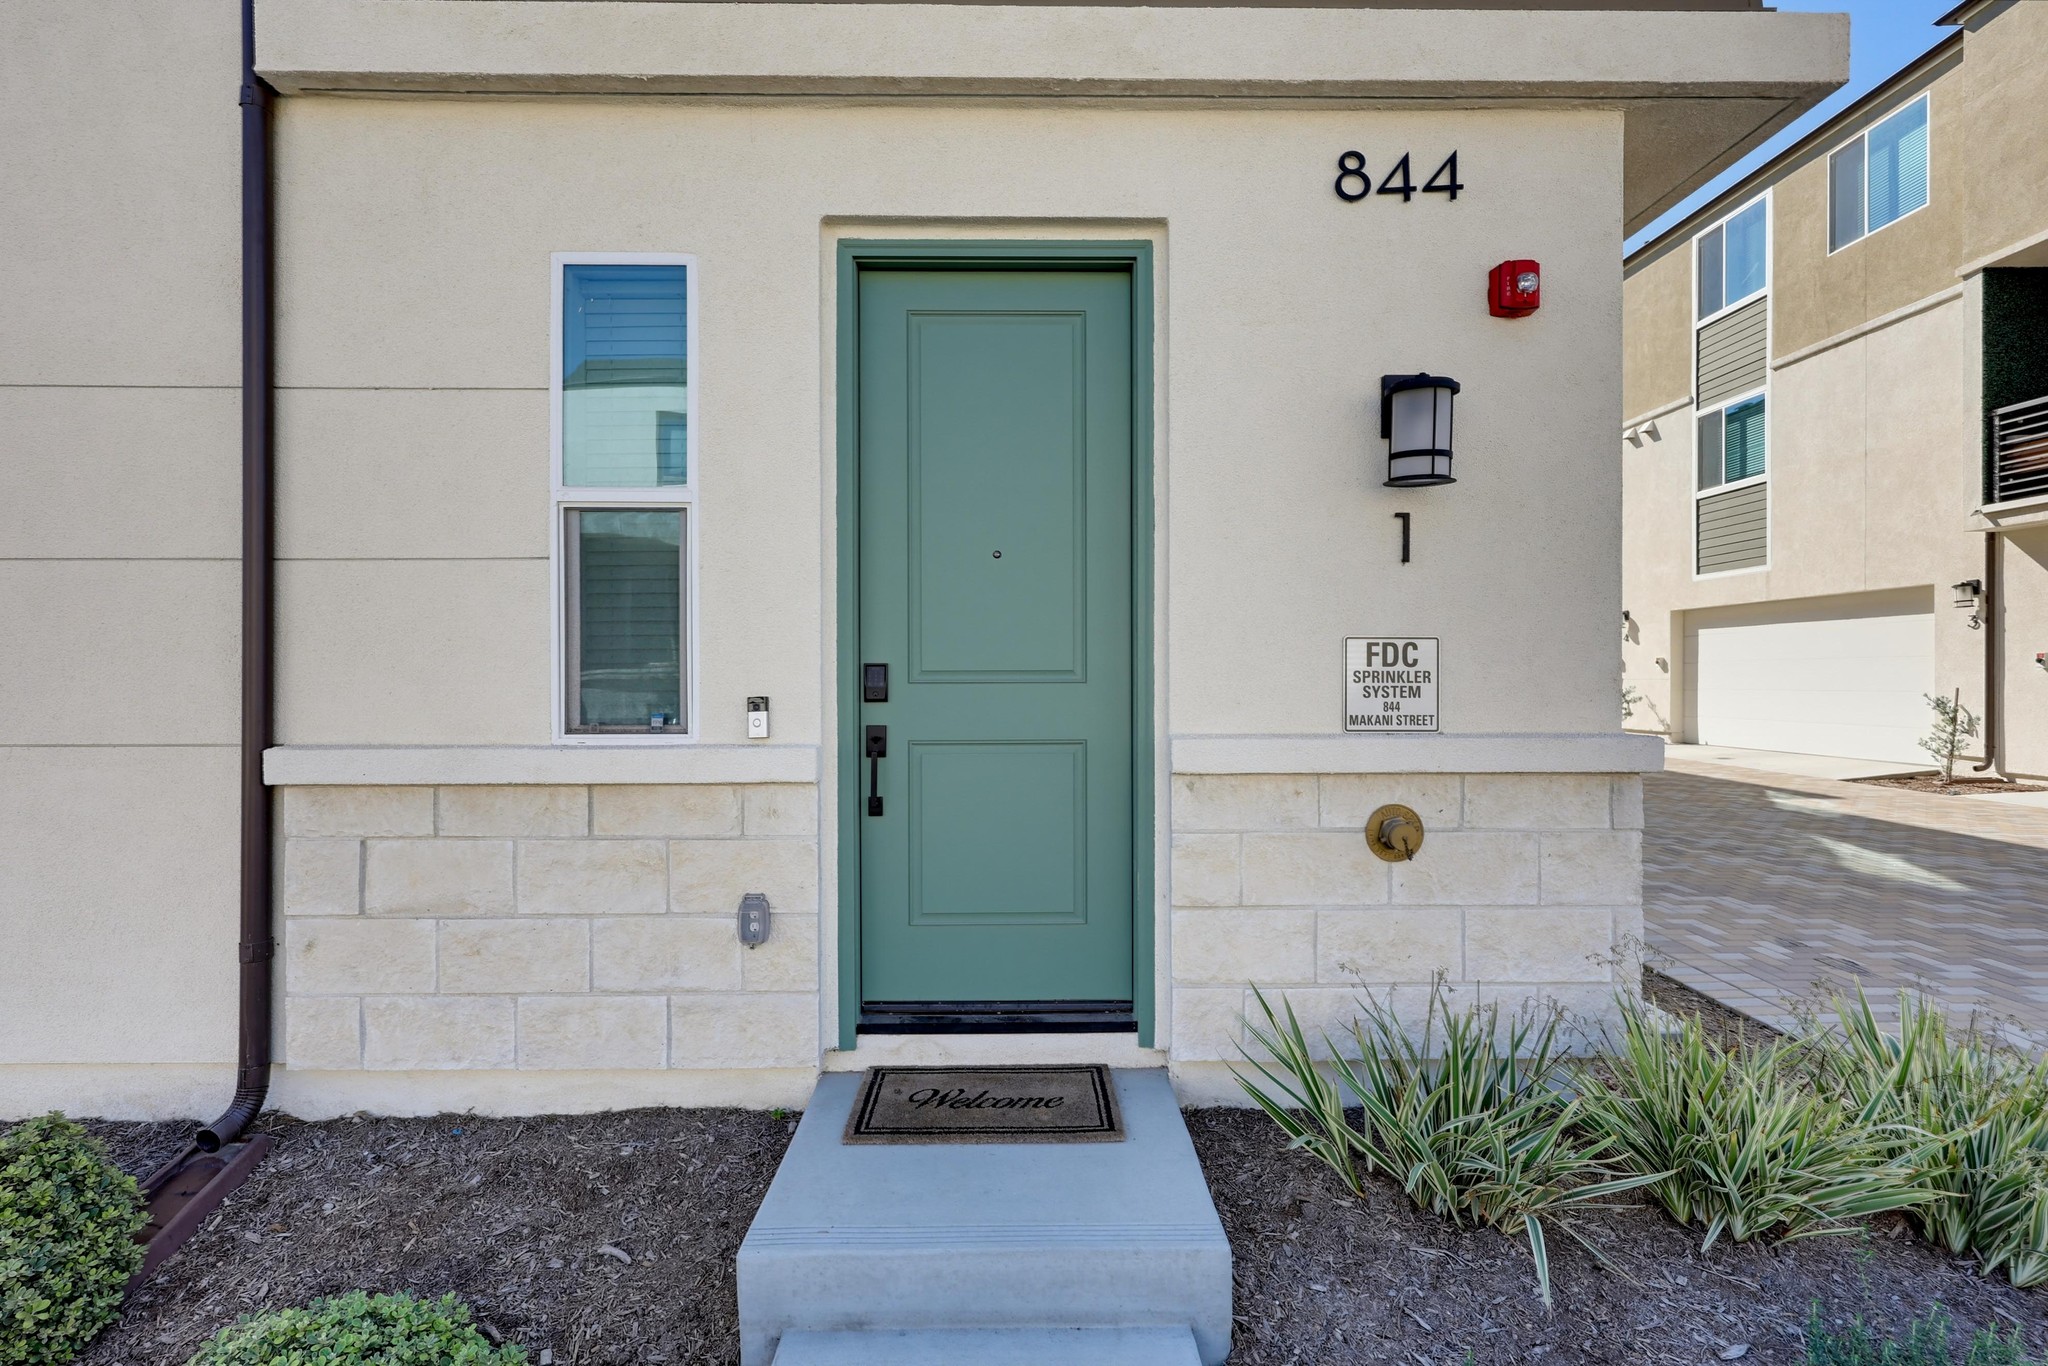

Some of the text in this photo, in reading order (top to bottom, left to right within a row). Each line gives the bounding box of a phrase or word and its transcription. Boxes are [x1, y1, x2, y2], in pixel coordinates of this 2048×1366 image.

[1335, 149, 1464, 202] 844
[1395, 513, 1410, 563] 1
[1366, 642, 1419, 668] FDC
[1353, 670, 1432, 684] SPRINKLER
[1362, 685, 1422, 699] SYSTEM
[1383, 701, 1401, 712] 844
[1349, 715, 1435, 726] MAKANI STREET
[908, 1088, 1064, 1110] Welcome
